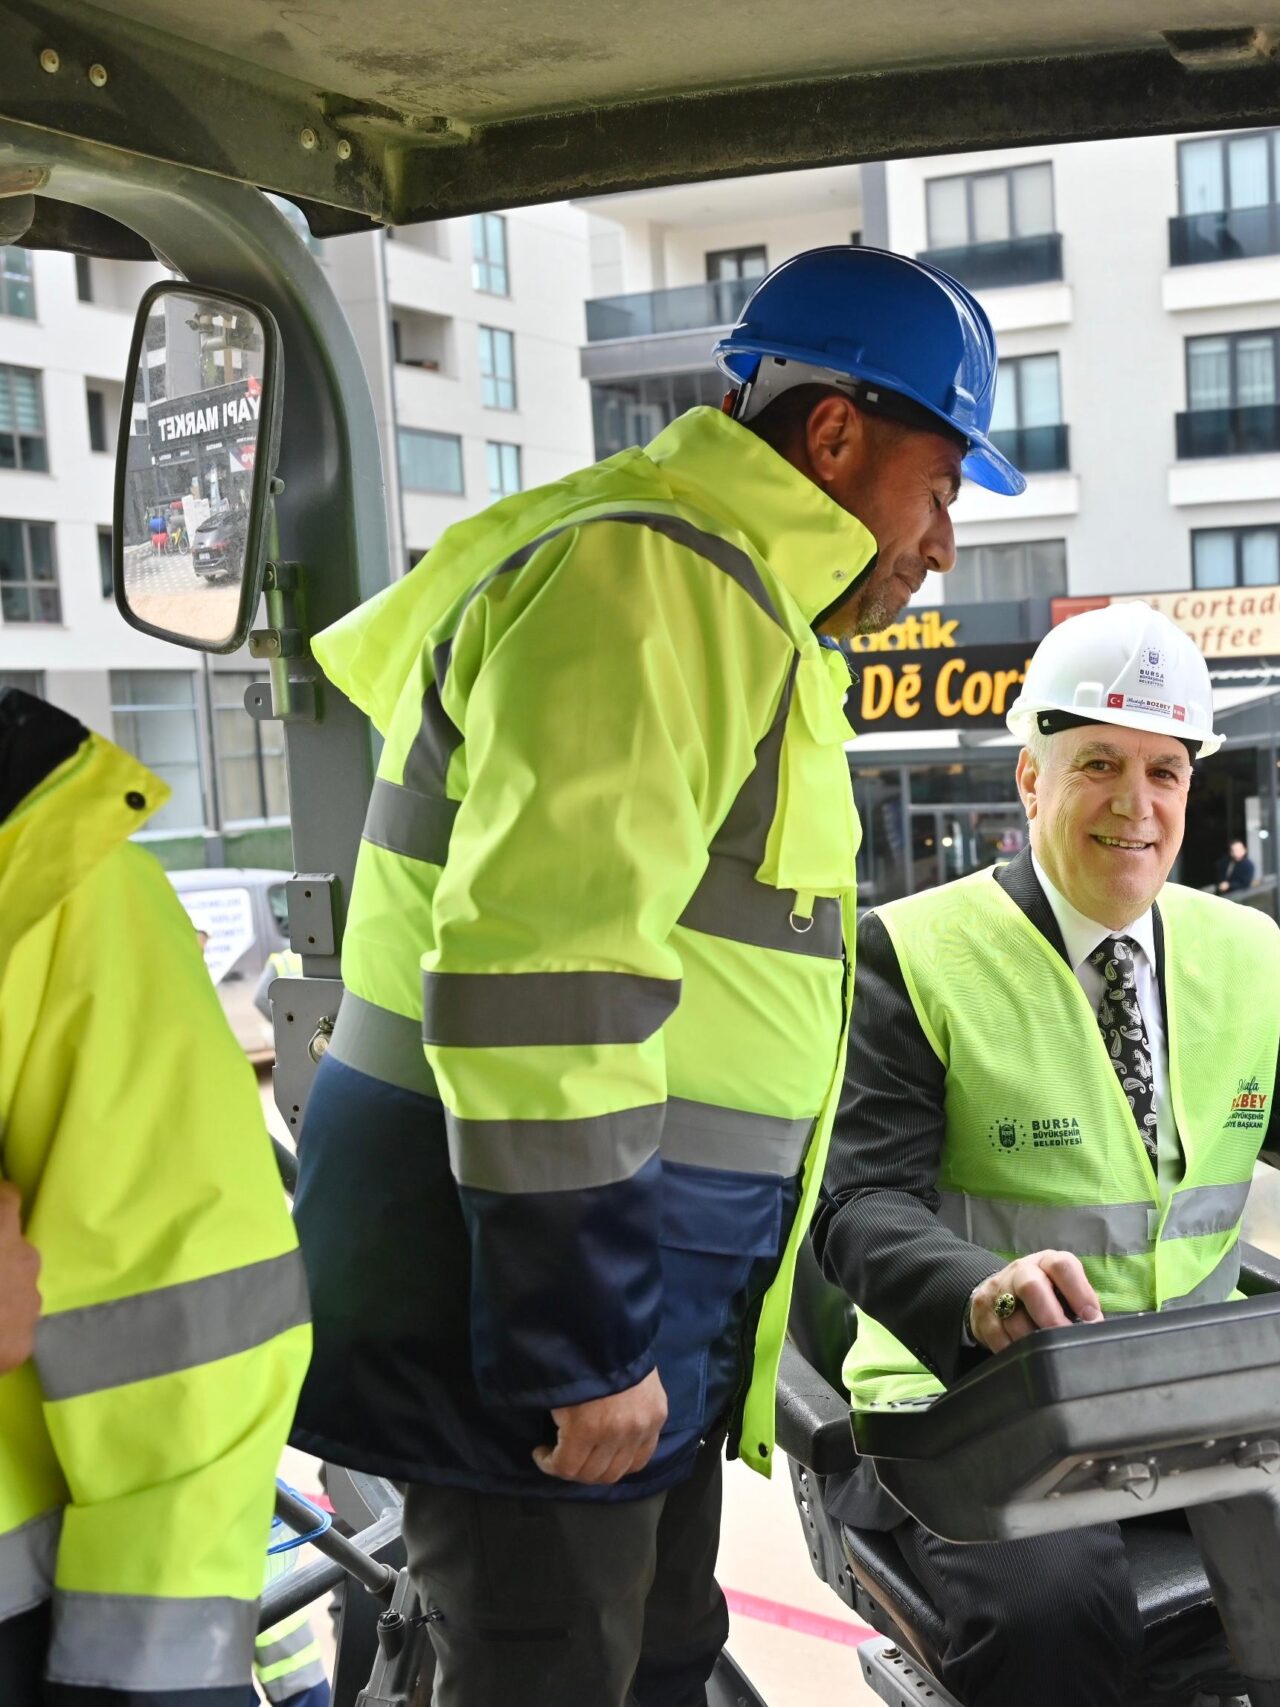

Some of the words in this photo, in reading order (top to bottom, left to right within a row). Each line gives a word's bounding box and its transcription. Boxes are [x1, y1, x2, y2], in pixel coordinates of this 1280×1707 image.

[1139, 669, 1164, 678] BURSA
[1146, 700, 1171, 710] BOZBEY
[1032, 1117, 1079, 1131] BURSA
[1034, 1136, 1082, 1147] BELEDİYESİ
